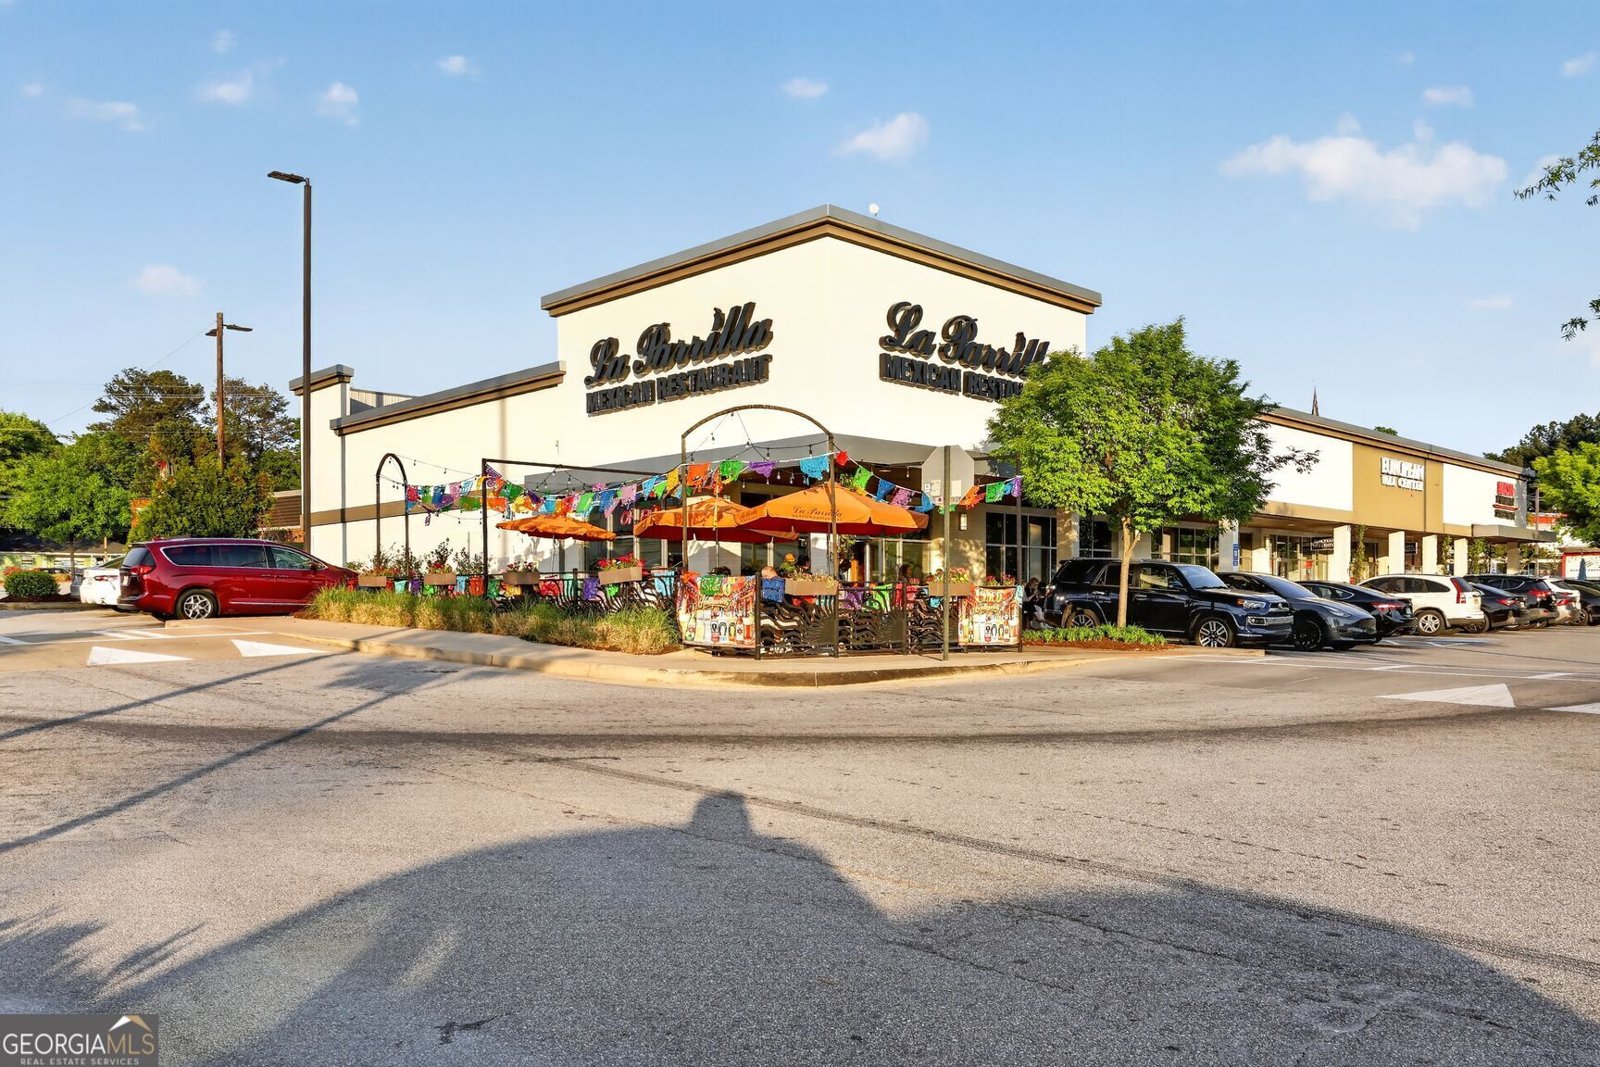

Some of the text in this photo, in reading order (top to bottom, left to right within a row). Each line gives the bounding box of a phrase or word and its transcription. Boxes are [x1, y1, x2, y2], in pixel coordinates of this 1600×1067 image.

[584, 302, 774, 390] La Parrilla
[879, 301, 1050, 379] La Parrill
[586, 354, 773, 417] MEXICAN RESTAURANT
[879, 353, 1024, 404] MEXICAN RESTAU
